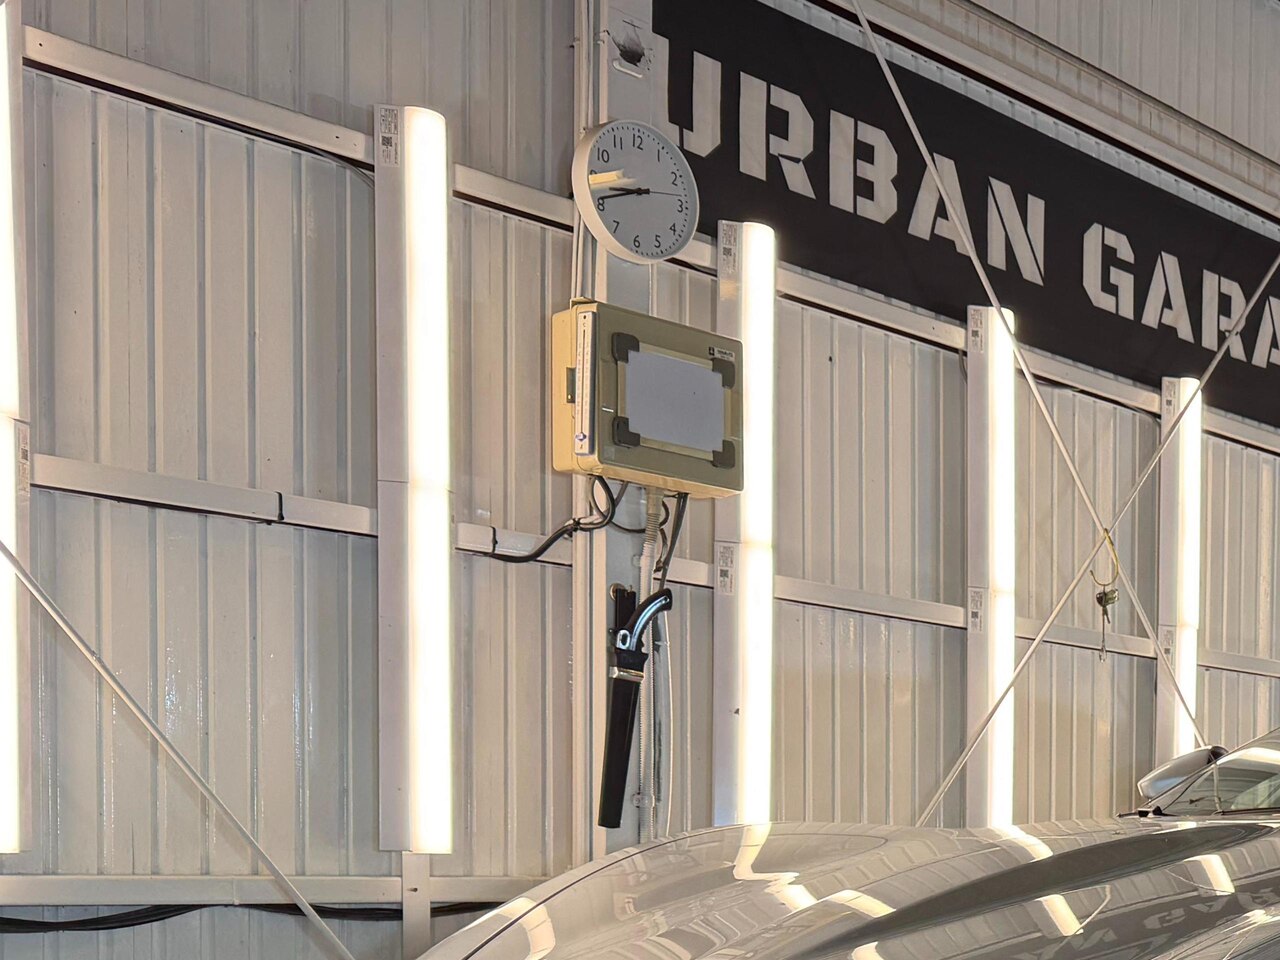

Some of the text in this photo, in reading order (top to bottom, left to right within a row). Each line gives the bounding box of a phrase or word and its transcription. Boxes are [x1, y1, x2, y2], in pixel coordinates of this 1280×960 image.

[613, 134, 623, 150] 11
[632, 133, 644, 151] 12
[597, 147, 610, 163] 10
[652, 32, 1045, 287] URBAN
[671, 171, 679, 187] 2
[597, 198, 606, 212] 8
[677, 199, 684, 213] 3
[612, 219, 620, 234] 7
[669, 222, 677, 236] 4
[633, 234, 641, 249] 6
[654, 234, 661, 249] 5
